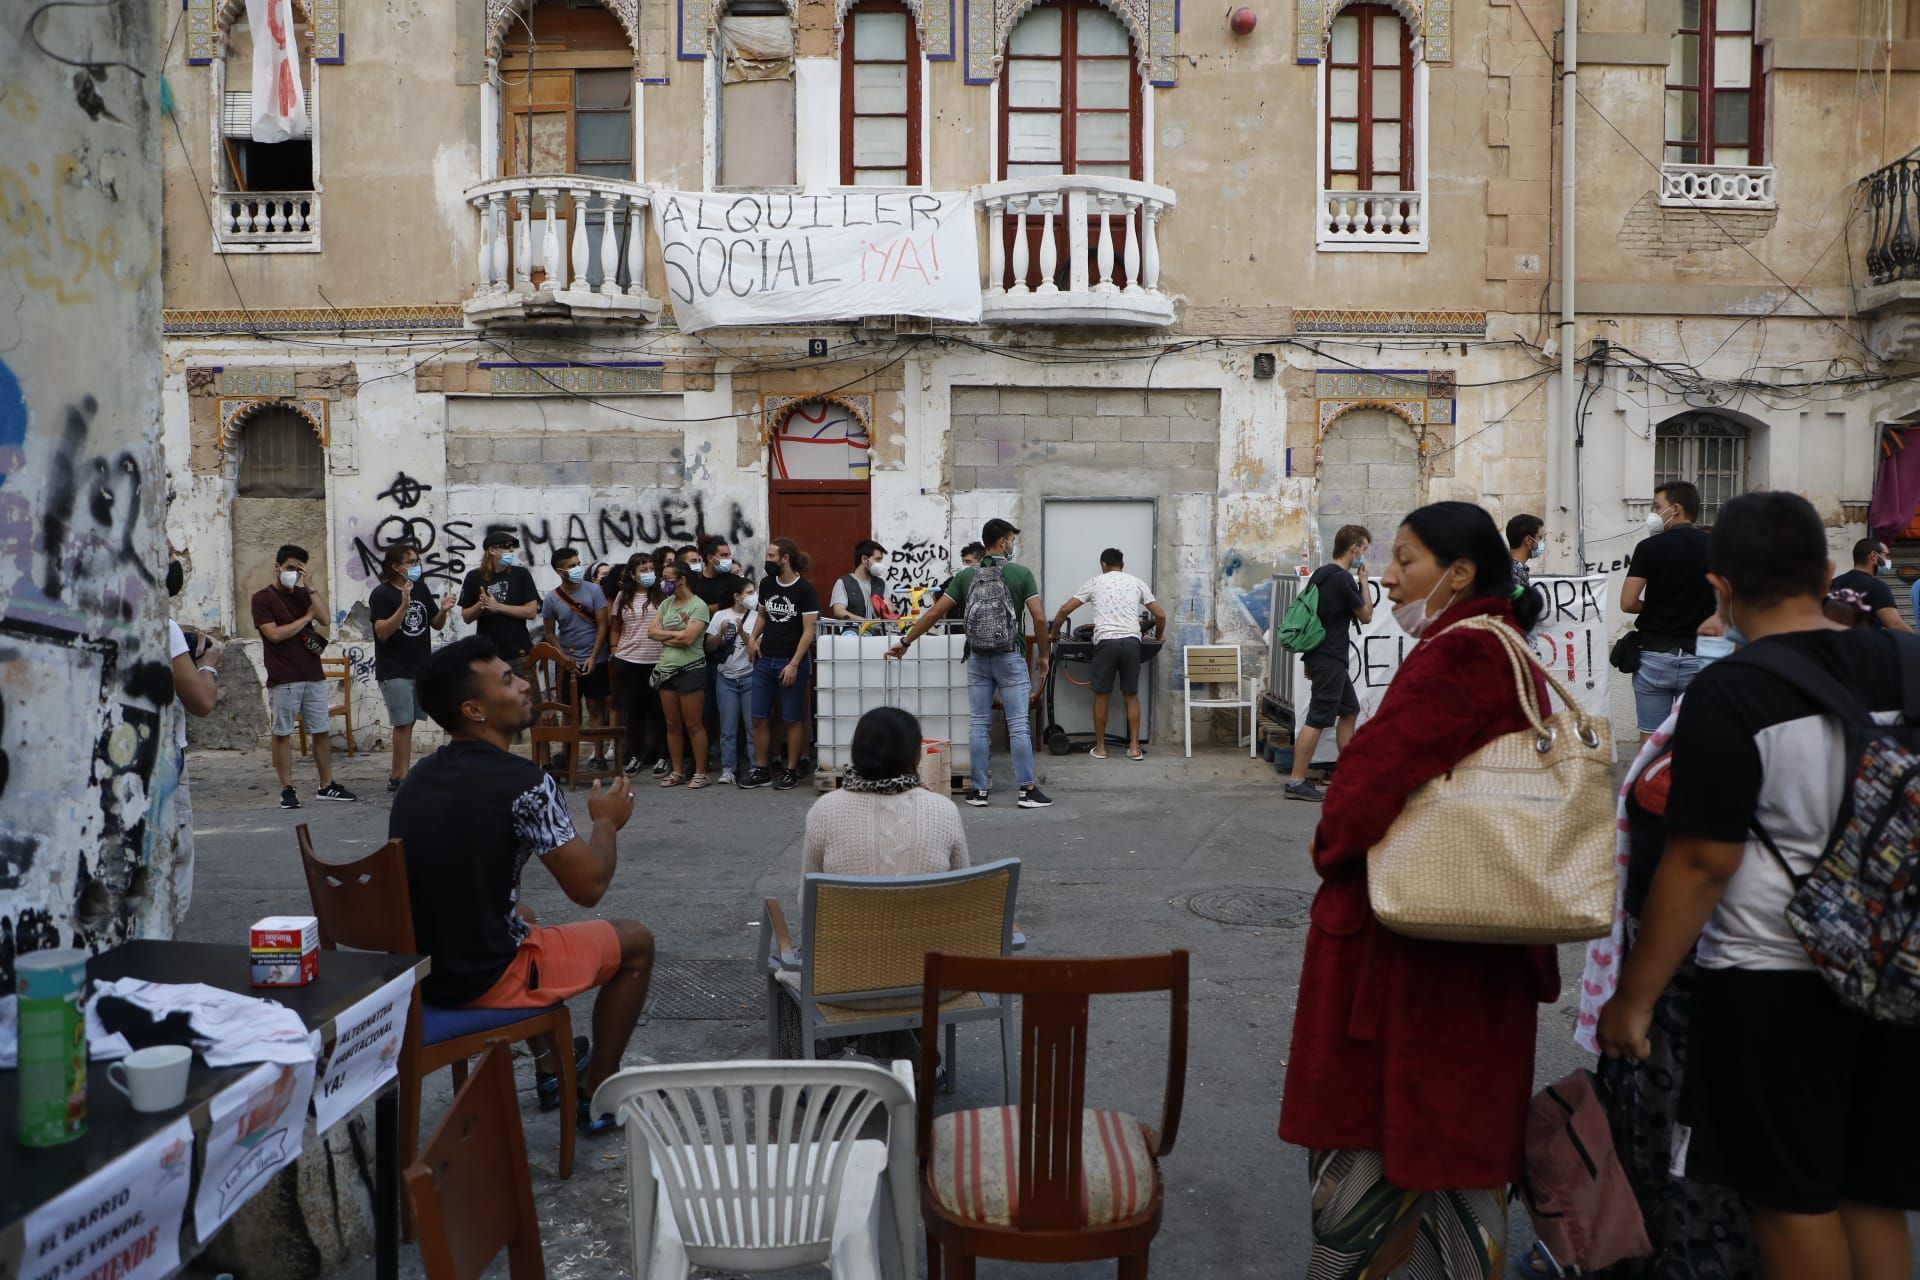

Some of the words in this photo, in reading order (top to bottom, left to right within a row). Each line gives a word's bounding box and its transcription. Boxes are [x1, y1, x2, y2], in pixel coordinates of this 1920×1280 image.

[663, 194, 942, 241] ALQUILER
[663, 235, 841, 304] SOCIAL
[814, 341, 823, 354] 9
[339, 1002, 393, 1046] ALTERNATIVA
[324, 1071, 346, 1098] YA!
[38, 1233, 58, 1258] EL
[63, 1187, 131, 1241] BARRIO
[64, 1248, 85, 1274] SE
